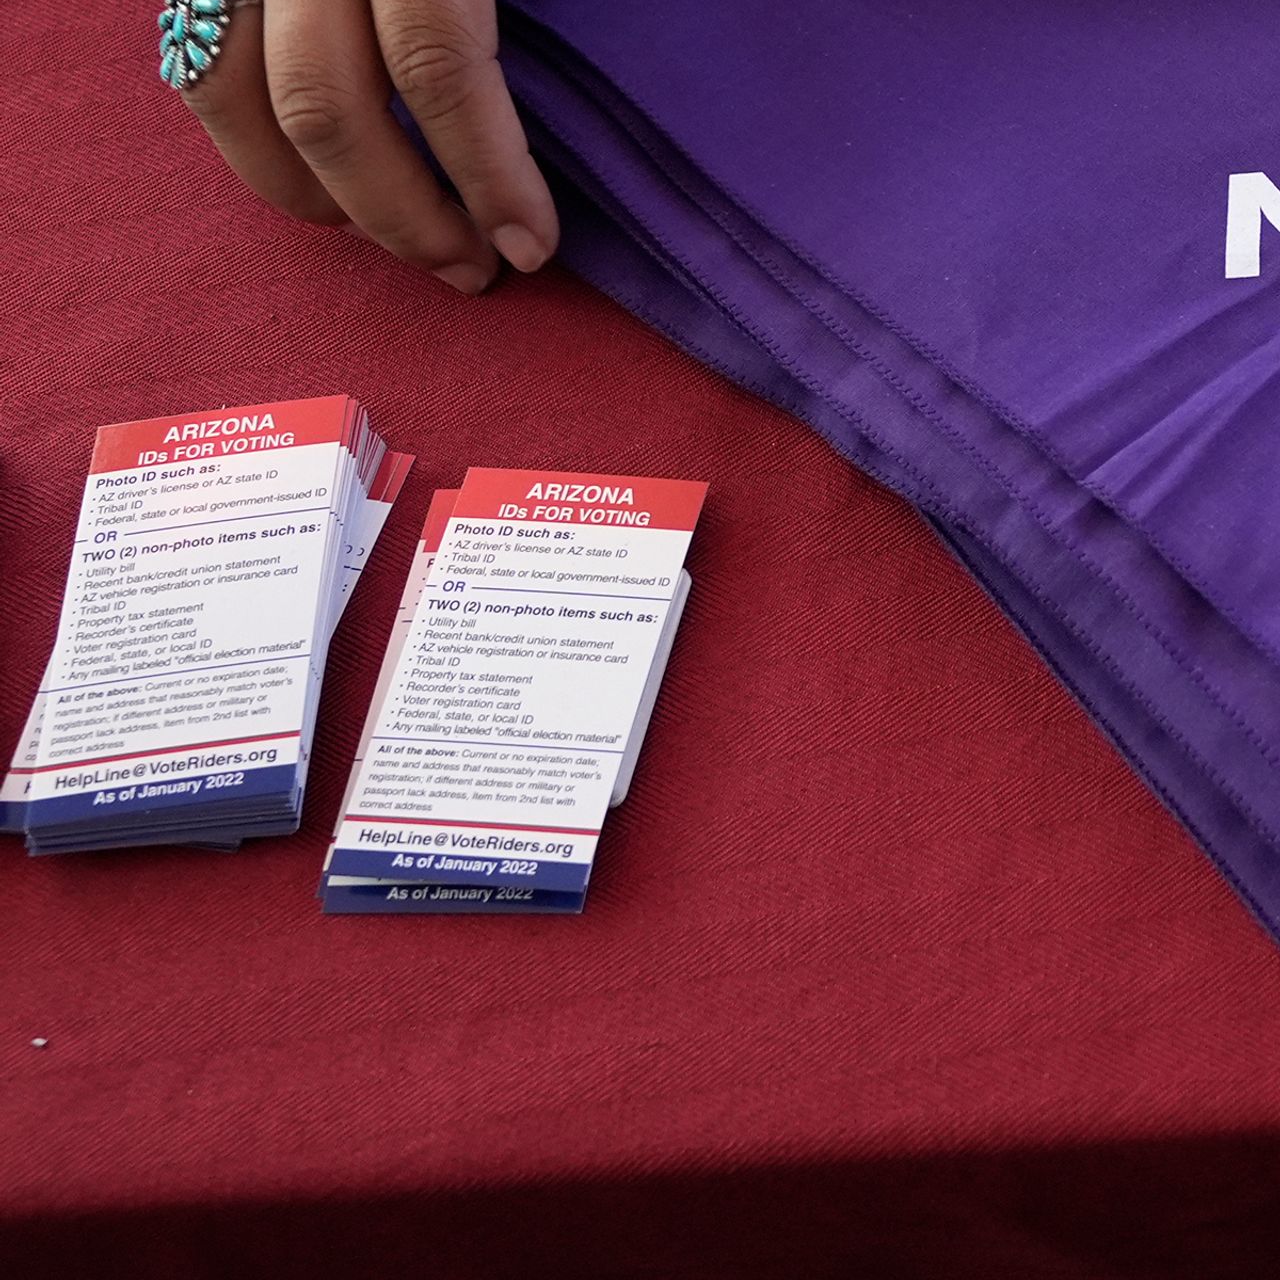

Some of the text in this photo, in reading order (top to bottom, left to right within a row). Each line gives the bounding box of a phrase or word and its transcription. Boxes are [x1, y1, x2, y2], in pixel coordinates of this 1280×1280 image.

[163, 413, 277, 444] ARIZONA
[136, 431, 296, 466] IDs FOR VOTING
[96, 464, 221, 489] Photo ID such as:
[526, 482, 636, 506] ARIZONA
[497, 504, 650, 526] IDs FOR VOTING
[93, 529, 118, 544] OR
[454, 523, 575, 541] Photo ID such as:
[81, 523, 322, 564] TWO (2) non-photo items such as:
[454, 540, 628, 559] AZ driver's license or AZ state ID
[452, 552, 496, 564] Tribal ID
[446, 564, 671, 587] Federal, state or local government-issued ID
[442, 580, 466, 593] OR
[428, 600, 658, 624] TWO (2) non-photo items such as:
[428, 617, 476, 629] Utility bill
[423, 630, 614, 650] Recent bank/credit union statement
[416, 655, 461, 668] Tribal ID
[418, 642, 629, 664] AZ vehicle registration or insurance card
[410, 669, 533, 685] Property tax statement
[406, 681, 521, 698] Recorder's certificate
[402, 694, 521, 711] Voter registration card
[54, 747, 279, 790] HelpLine@VoteRiders.org
[93, 773, 245, 806] As of January 2022
[358, 829, 574, 857] HelpLine@VoteRiders.org
[391, 855, 538, 875] As of January 2022
[385, 887, 533, 904] As of January 2022
